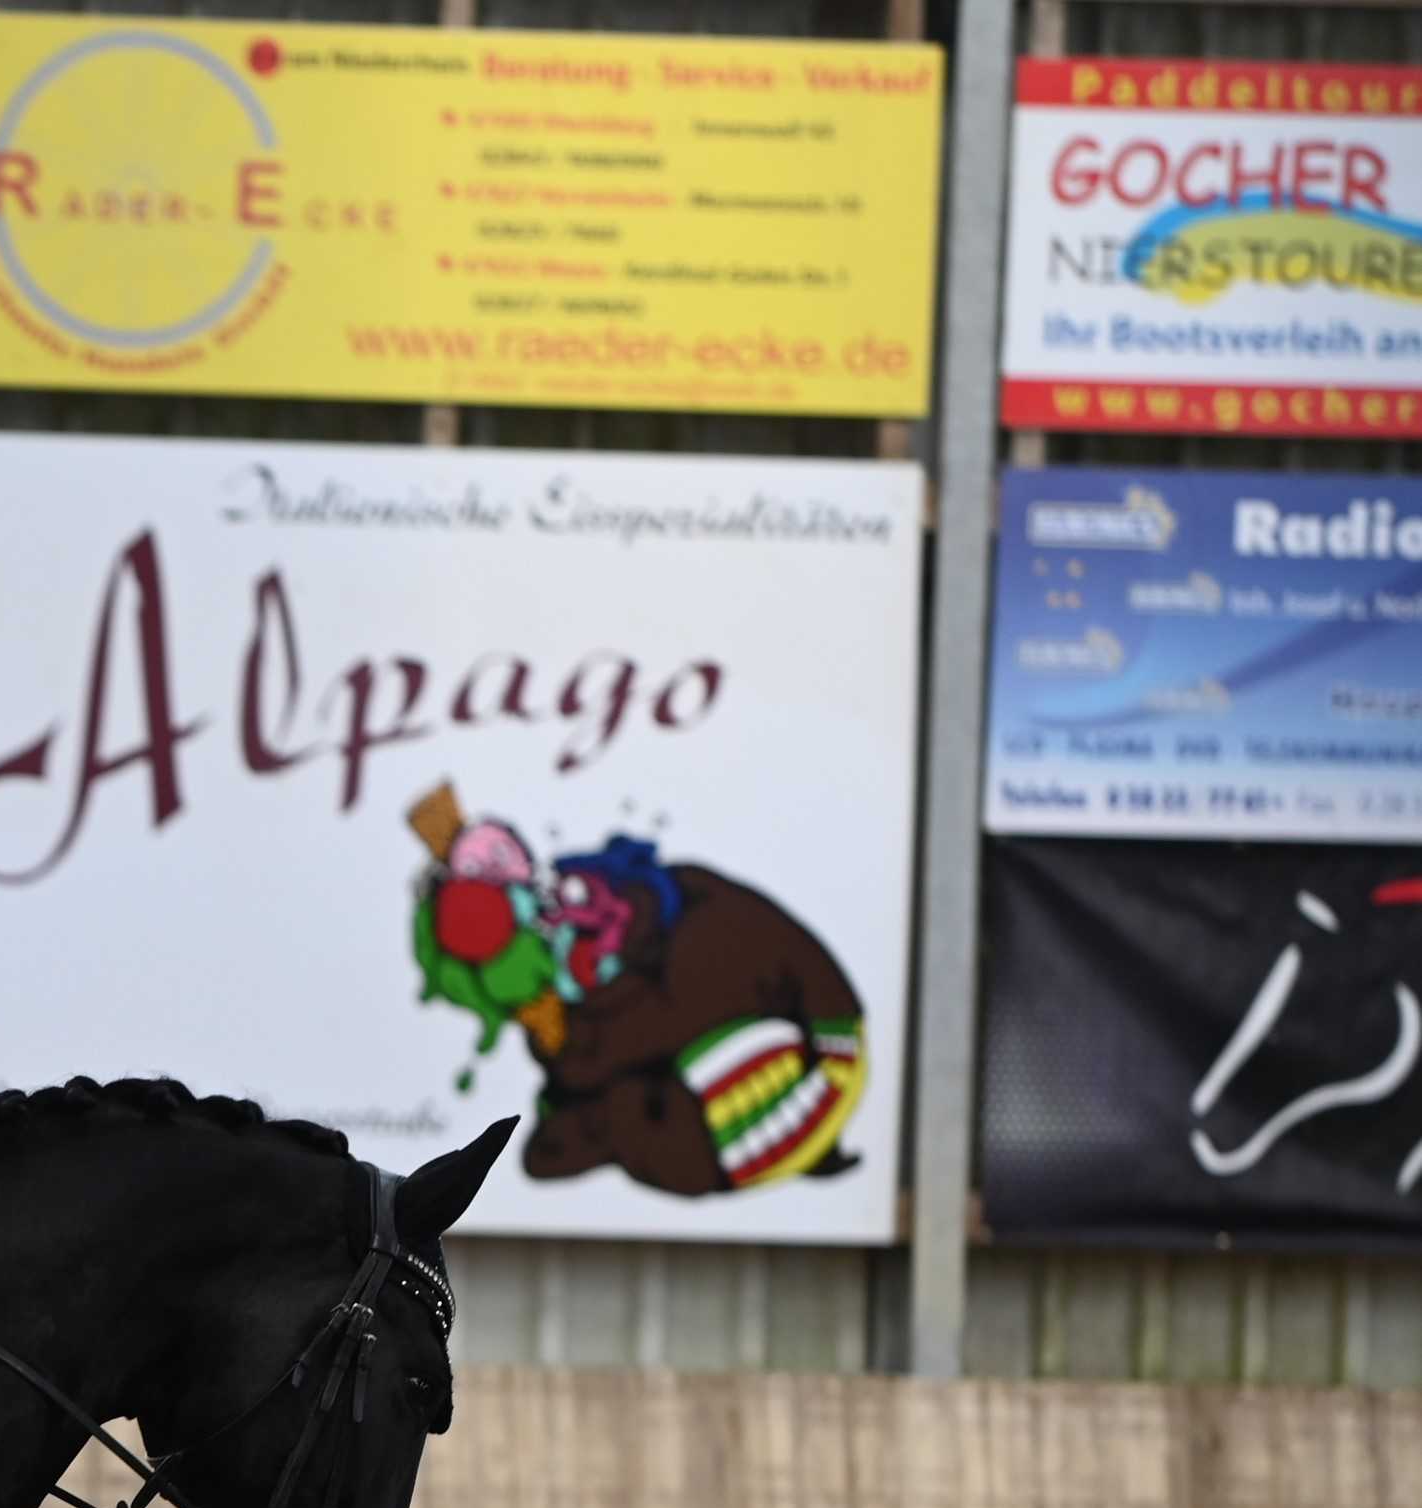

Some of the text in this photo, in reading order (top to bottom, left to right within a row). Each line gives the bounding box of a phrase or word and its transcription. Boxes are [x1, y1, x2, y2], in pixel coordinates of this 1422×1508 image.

[482, 52, 933, 95] Beratung Service Verkauf
[1049, 136, 1390, 214] GOCHER
[1043, 314, 1098, 350] Ihr
[1110, 315, 1362, 356] Bootsverleih
[1232, 497, 1422, 561] Radio
